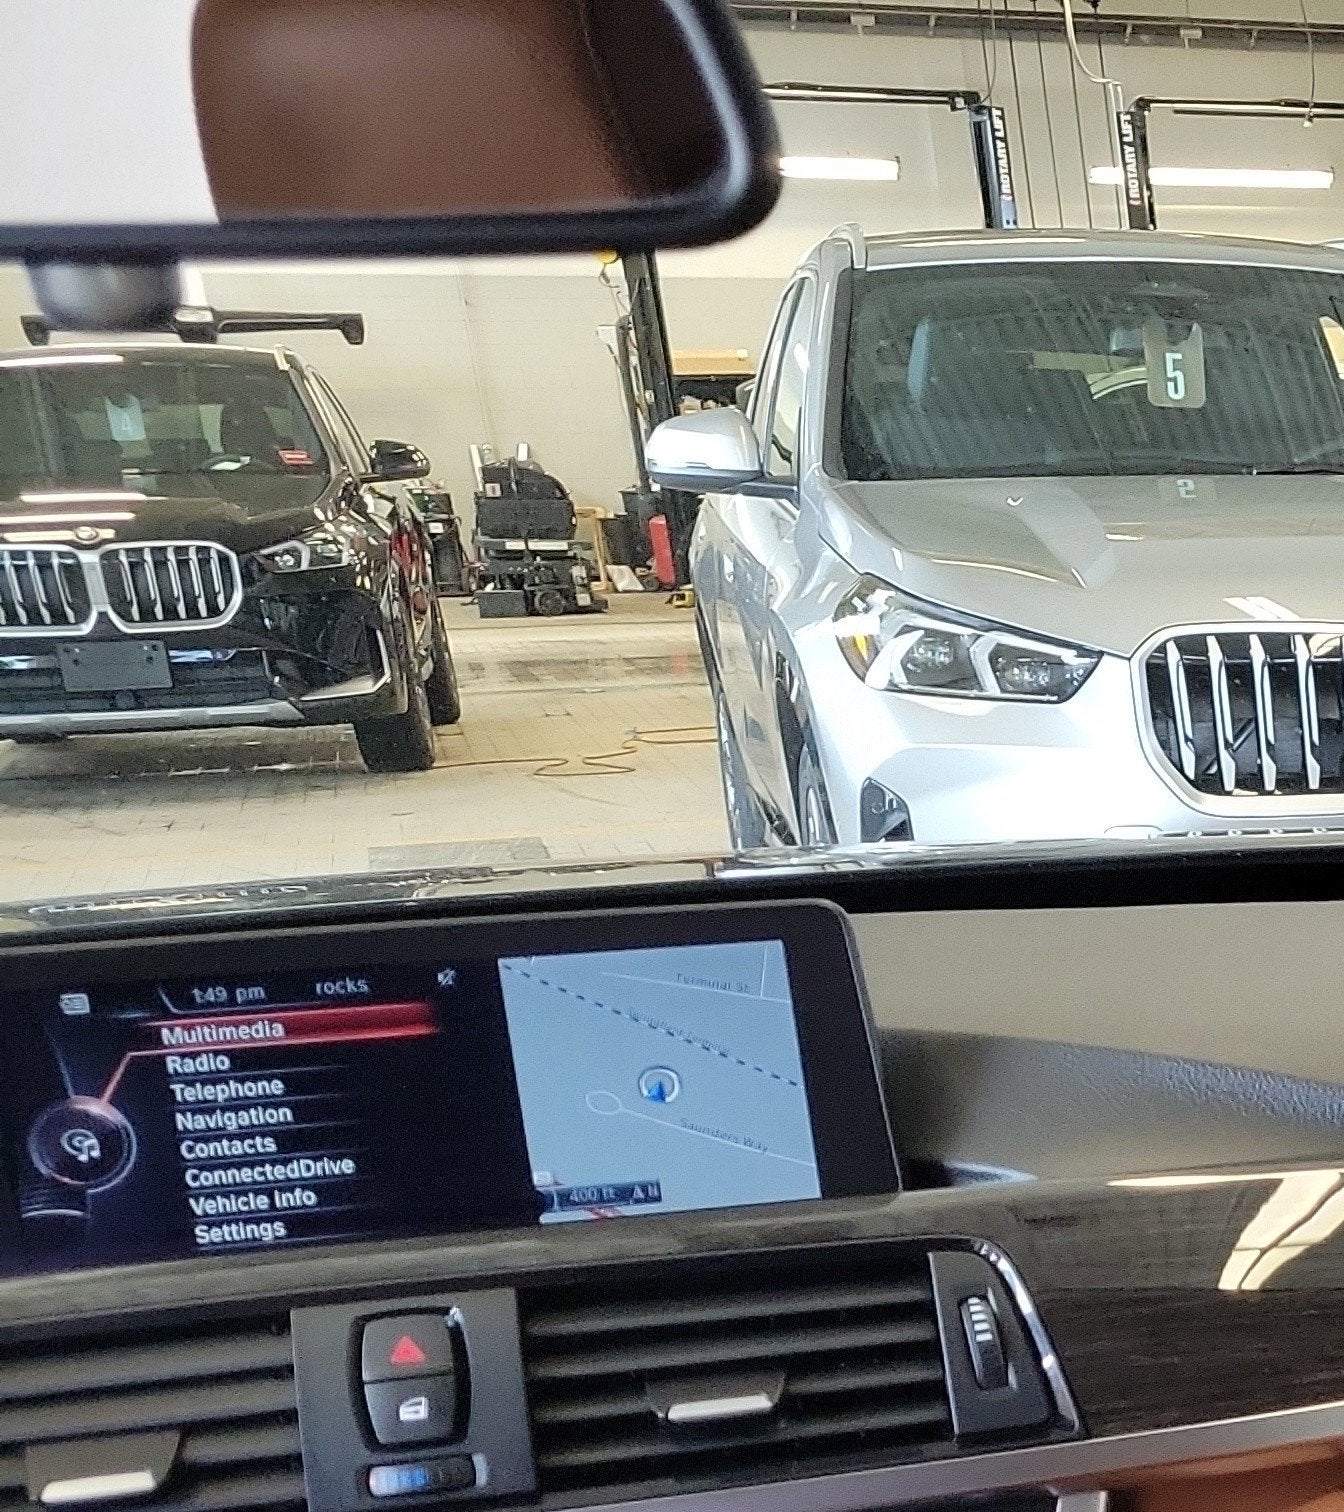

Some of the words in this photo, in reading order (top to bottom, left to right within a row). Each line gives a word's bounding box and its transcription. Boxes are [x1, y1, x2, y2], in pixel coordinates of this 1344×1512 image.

[992, 107, 1005, 138] LIFT
[1119, 113, 1134, 142] LIFT
[996, 139, 1012, 194] ROTARY
[1122, 144, 1140, 199] ROTARY
[1165, 352, 1186, 400] 5
[235, 986, 266, 1004] pm
[315, 977, 370, 996] rocks
[161, 1020, 285, 1047] Multimedia
[166, 1053, 231, 1075] Radio
[170, 1077, 285, 1104] Telephone
[175, 1105, 294, 1133] Navigation
[180, 1135, 278, 1160] Contacts
[184, 1157, 356, 1188] ConnectedDrive
[189, 1191, 269, 1216] Vehicle
[274, 1187, 318, 1208] Info
[194, 1219, 287, 1246] Settings
